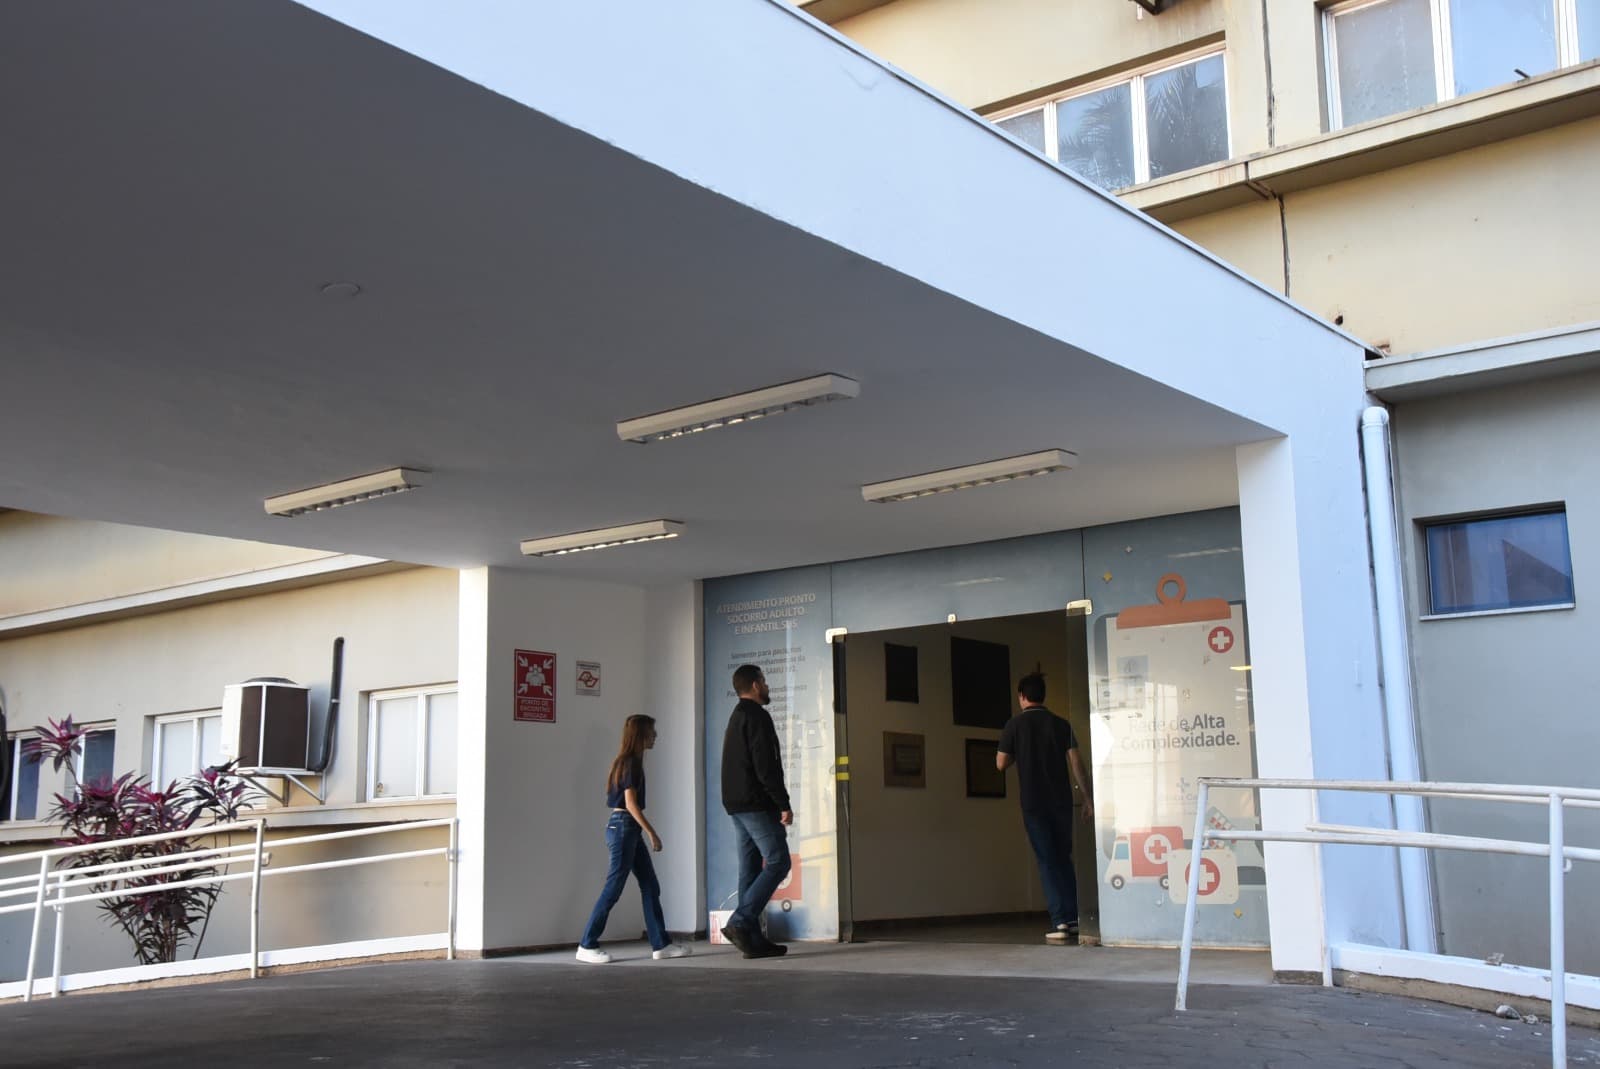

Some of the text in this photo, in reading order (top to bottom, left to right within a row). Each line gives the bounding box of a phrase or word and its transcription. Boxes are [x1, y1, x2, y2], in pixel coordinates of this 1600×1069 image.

[716, 593, 816, 614] ATENDIMENTO PRONTO
[727, 606, 805, 625] SOCORRO ADULTO
[741, 621, 780, 634] INFANTIL
[1192, 713, 1225, 730] Alta
[1120, 730, 1241, 751] Complexidade.
